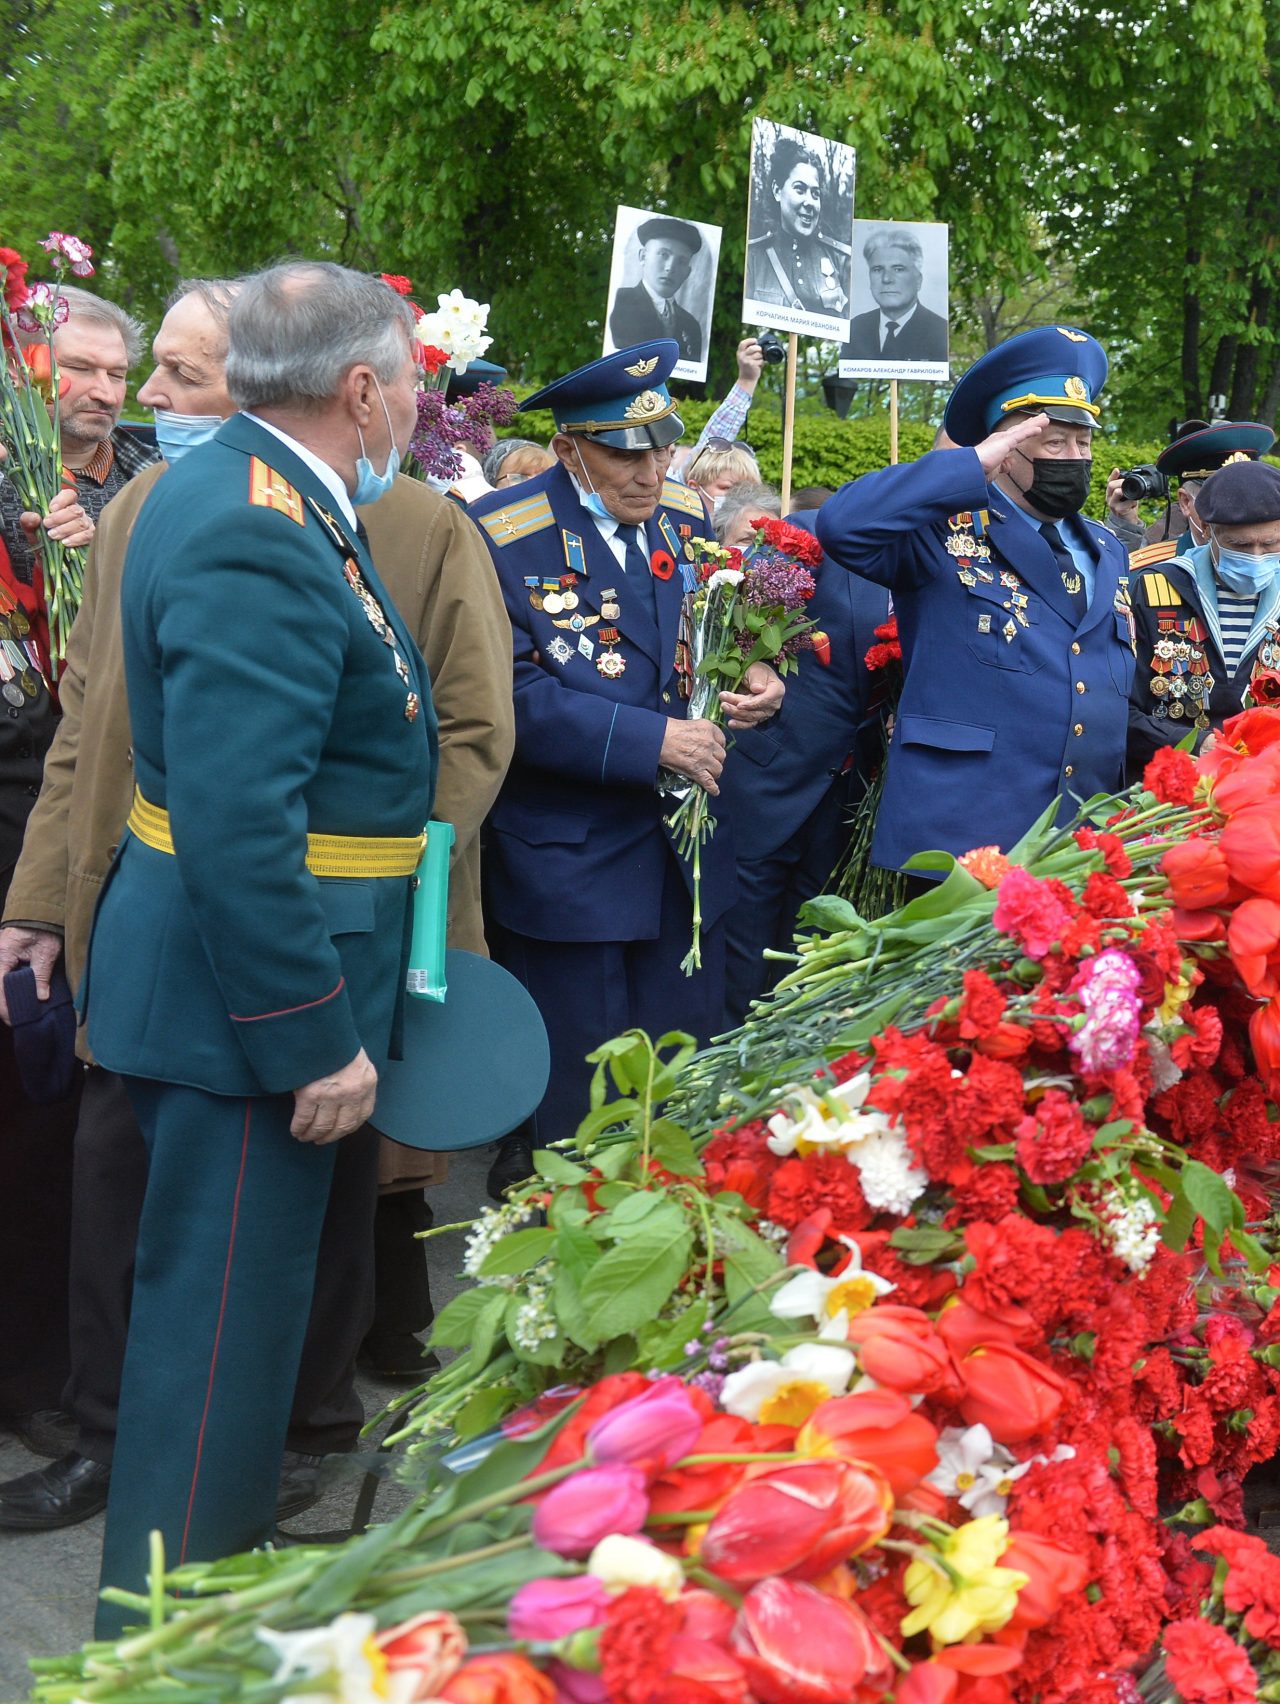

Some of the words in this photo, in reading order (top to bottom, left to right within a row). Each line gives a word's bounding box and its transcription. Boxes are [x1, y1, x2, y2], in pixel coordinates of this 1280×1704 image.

[756, 310, 789, 321] КОРЧАГИНА
[790, 317, 810, 327] МАРИЯ
[811, 321, 840, 332] ИВАНОВНА
[674, 366, 697, 374] ИМОВИЧ
